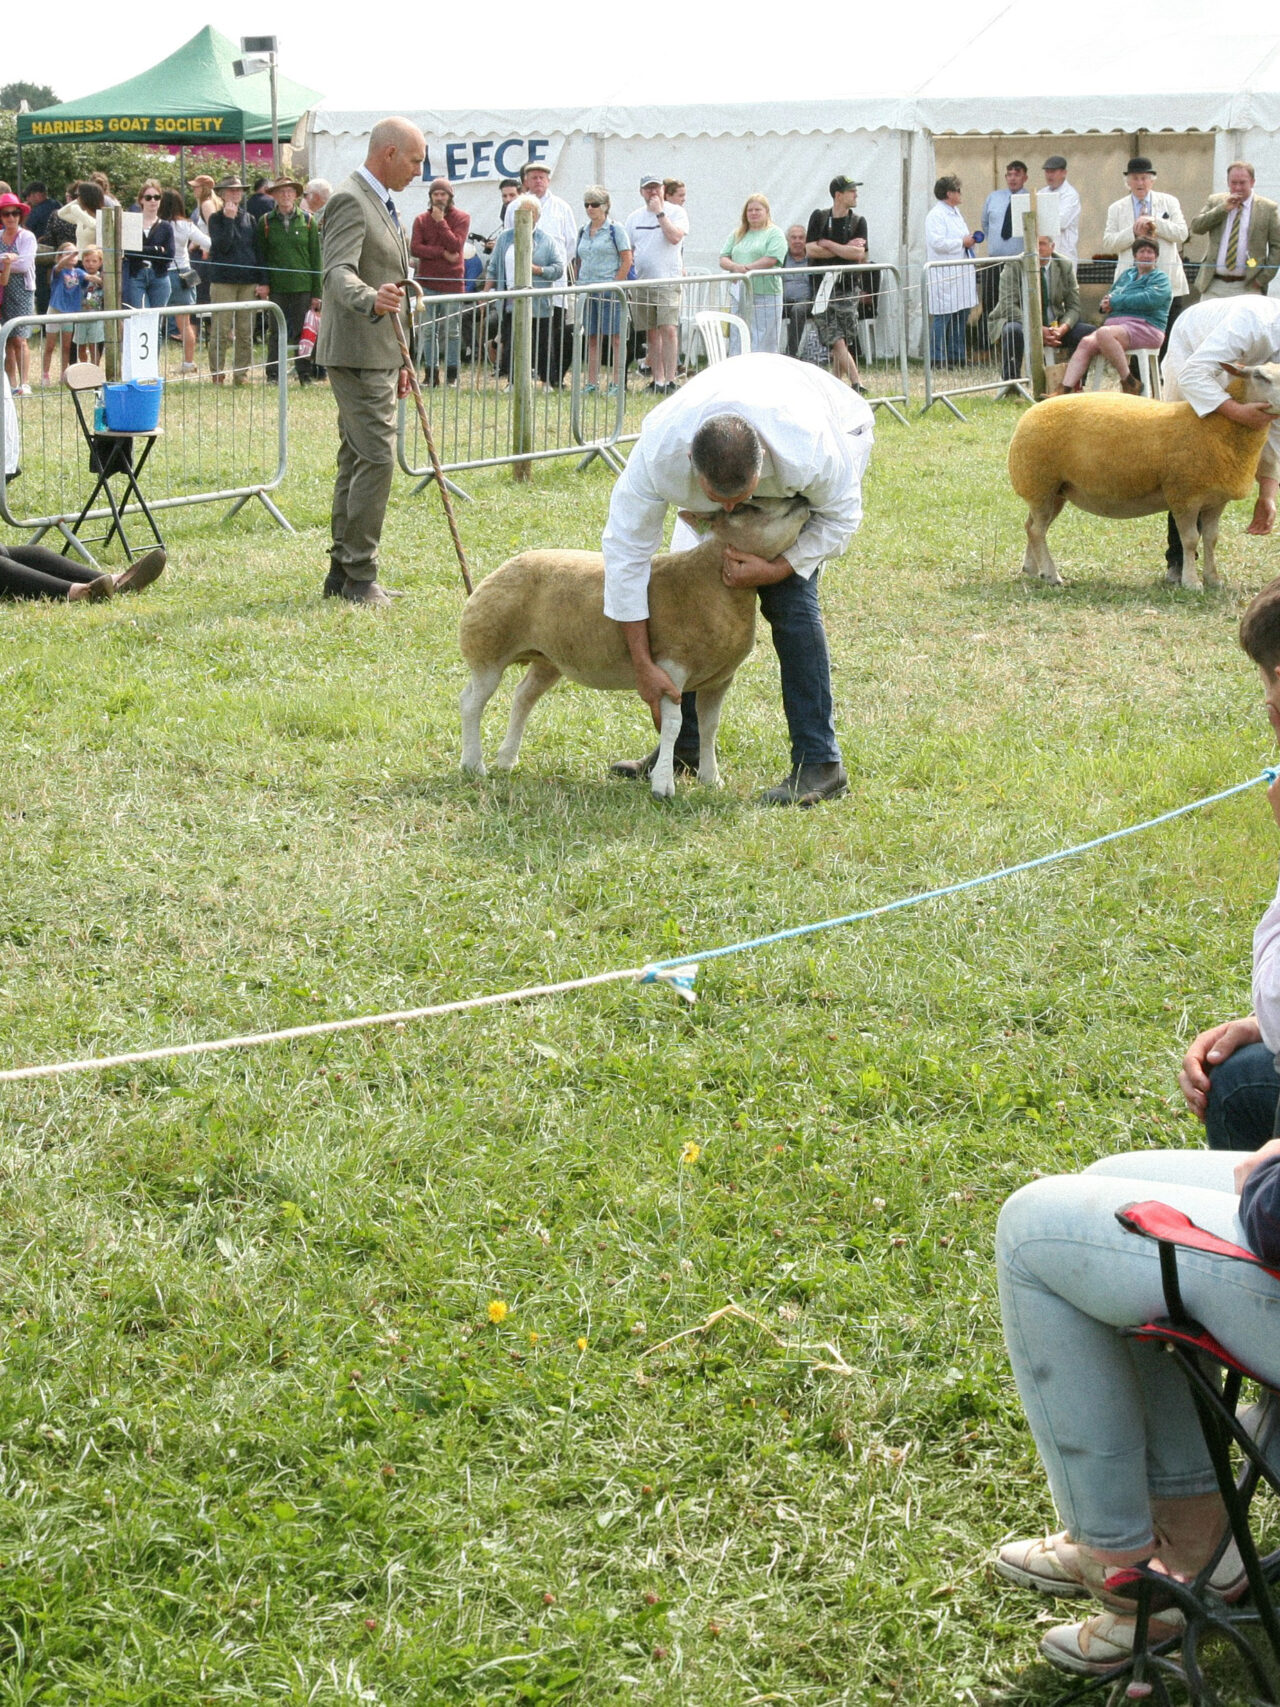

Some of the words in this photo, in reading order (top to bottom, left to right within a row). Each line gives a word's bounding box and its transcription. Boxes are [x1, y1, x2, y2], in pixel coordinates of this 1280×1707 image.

[31, 119, 104, 135] HARNESS
[108, 117, 150, 132] GOAT
[155, 117, 224, 132] SOCIETY
[422, 138, 549, 182] LEECE
[138, 331, 149, 361] 3
